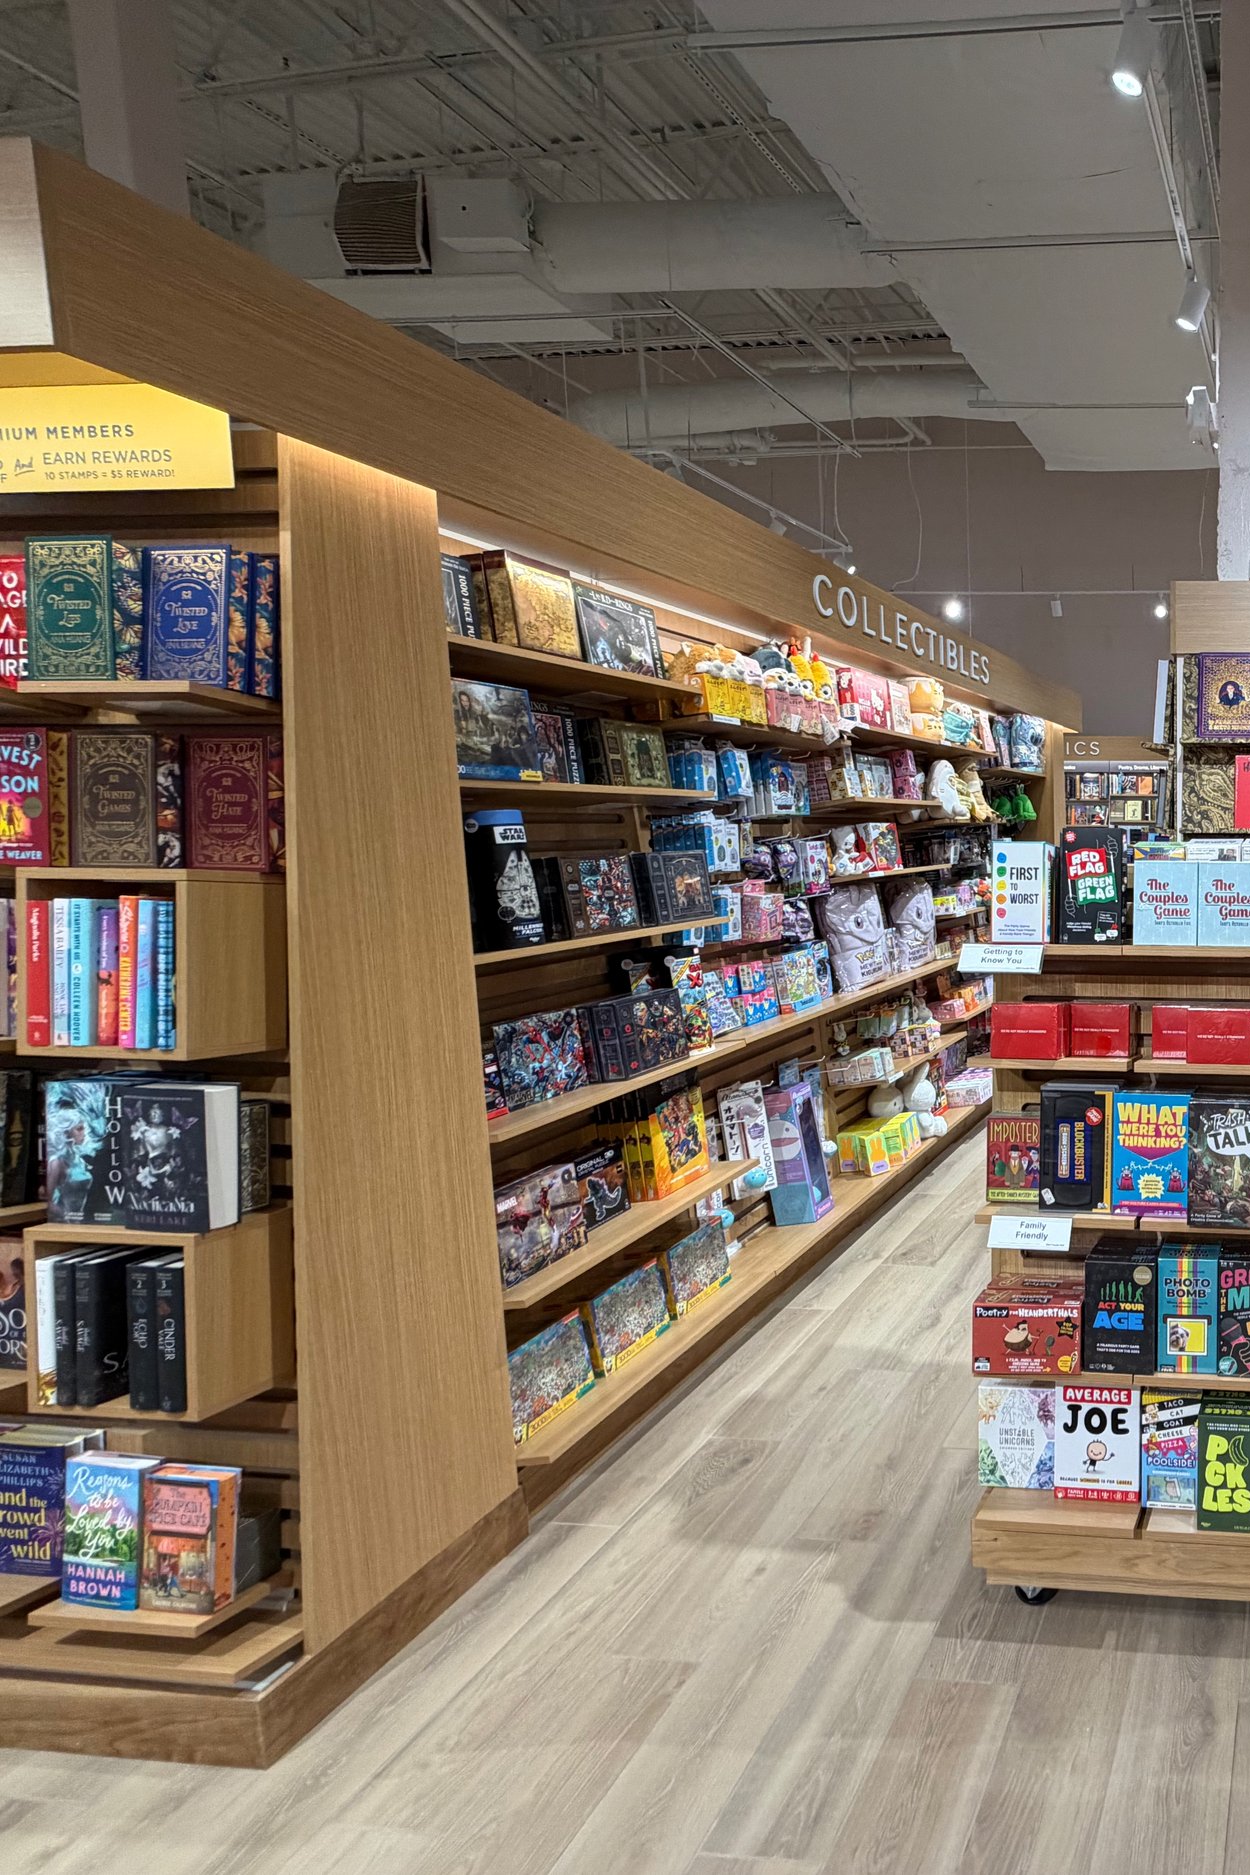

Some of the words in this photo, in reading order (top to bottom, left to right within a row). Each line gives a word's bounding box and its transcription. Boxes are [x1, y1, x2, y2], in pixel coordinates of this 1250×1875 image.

[46, 424, 134, 439] MEMBERS
[14, 457, 35, 476] And
[43, 451, 87, 465] EARN
[92, 449, 172, 464] REWARDS
[45, 472, 56, 480] 10
[58, 471, 99, 480] STAMPS
[110, 470, 124, 480] $5
[126, 469, 175, 479] REWARD!
[458, 574, 469, 597] 1000
[47, 594, 91, 610] TWISTED
[164, 600, 207, 616] TWISTED
[462, 598, 473, 624] PIECE
[812, 574, 991, 685] COLLECTIBLES
[565, 717, 574, 737] 1000
[568, 738, 577, 761] PIECE
[1066, 741, 1100, 756] ICS
[93, 784, 135, 801] TWISTED
[206, 787, 248, 803] TWISTED
[98, 800, 131, 816] GAMES
[211, 803, 242, 820] HATE
[6, 850, 42, 861] WEAVER
[1071, 851, 1100, 865] RED
[1009, 867, 1040, 881] FIRST
[1069, 862, 1105, 877] FLAG
[1010, 882, 1019, 891] TO
[1077, 876, 1114, 889] GREEN
[1147, 878, 1170, 891] The
[1212, 878, 1235, 891] The
[1009, 893, 1040, 905] WORST
[1079, 888, 1116, 903] FLAG
[1139, 891, 1189, 906] Couples
[1154, 905, 1191, 920] Game
[55, 906, 64, 935] TESSA
[983, 947, 1013, 957] Getting
[1014, 948, 1023, 956] to
[980, 956, 1004, 965] Know
[1006, 957, 1022, 965] You
[73, 976, 82, 1010] COLLEEN
[73, 1011, 82, 1041] HOOVER
[1117, 1102, 1188, 1126] WHAT
[1209, 1109, 1247, 1131] TRASH
[1118, 1123, 1155, 1136] WERE
[1159, 1125, 1187, 1137] YOU
[1117, 1135, 1187, 1150] THINKING?
[1074, 1121, 1085, 1181] BLOCKBUSTER
[1020, 1220, 1047, 1232] Family
[1015, 1231, 1049, 1243] Friendly
[1164, 1277, 1211, 1288] PHOTO
[1166, 1288, 1207, 1299] BOMB
[976, 1307, 1008, 1318] Poetry
[1018, 1308, 1079, 1318] NEANDERTHALS
[1098, 1301, 1117, 1310] ACT
[1119, 1302, 1145, 1311] YOUR
[1093, 1311, 1145, 1331] AGE
[138, 1318, 148, 1349] ECHO
[163, 1318, 176, 1361] CINDER
[1066, 1388, 1129, 1403] AVERAGE
[1163, 1399, 1184, 1409] TACO
[1063, 1404, 1130, 1435] JOE
[1169, 1409, 1184, 1417] CAT
[1163, 1419, 1184, 1428] GOAT
[1000, 1427, 1035, 1438] UNSTABLE
[1157, 1430, 1184, 1440] CHEESE
[1000, 1437, 1035, 1447] UNICORNS
[1160, 1439, 1184, 1449] PIZZA
[2, 1453, 37, 1465] SUSAN
[1147, 1456, 1196, 1468] POOLSIDE!
[67, 1465, 134, 1499] Reasons
[169, 1487, 187, 1499] The
[29, 1497, 48, 1509] the
[66, 1505, 114, 1532] Loved
[114, 1511, 135, 1540] by
[10, 1542, 52, 1561] wild
[78, 1532, 117, 1562] You
[67, 1564, 126, 1583] HANNAH
[69, 1581, 121, 1599] BROWN
